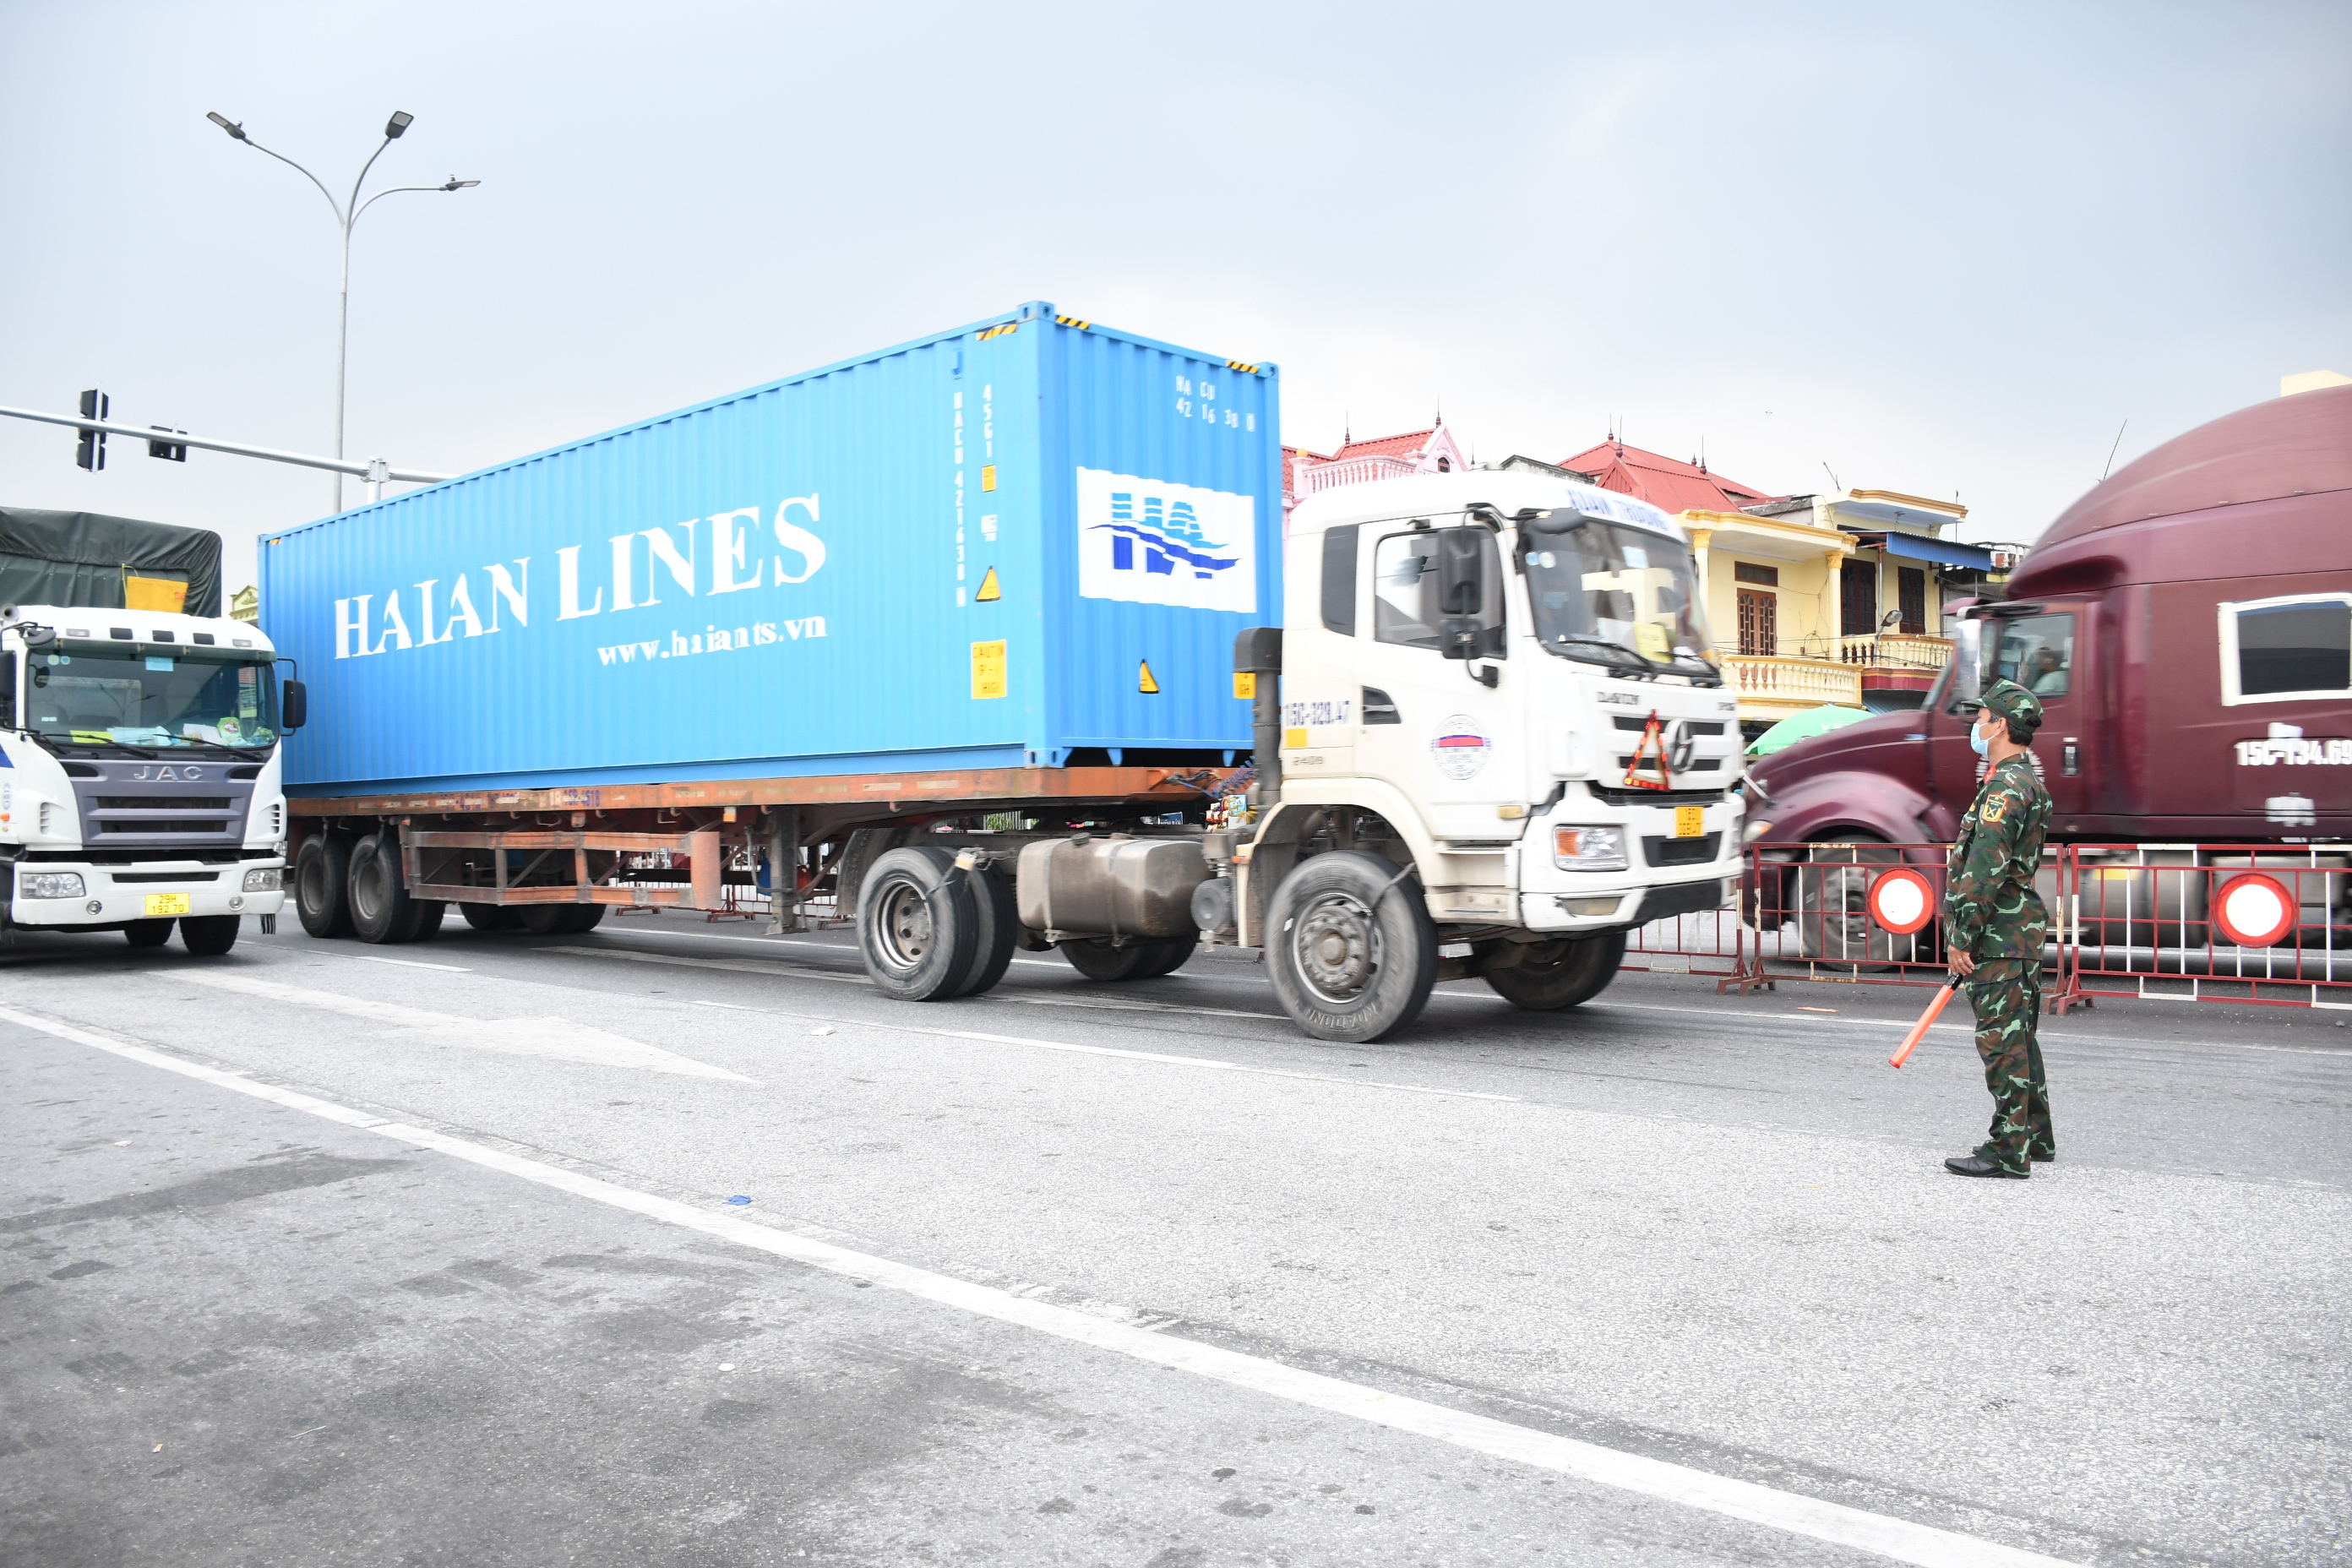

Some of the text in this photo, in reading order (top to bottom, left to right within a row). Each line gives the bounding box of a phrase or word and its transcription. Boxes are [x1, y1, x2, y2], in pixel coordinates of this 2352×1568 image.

[335, 493, 827, 659] HAIAN LINES
[2233, 739, 2352, 766] 15C-134.69
[133, 765, 203, 781] JAC
[159, 895, 177, 904] 29H
